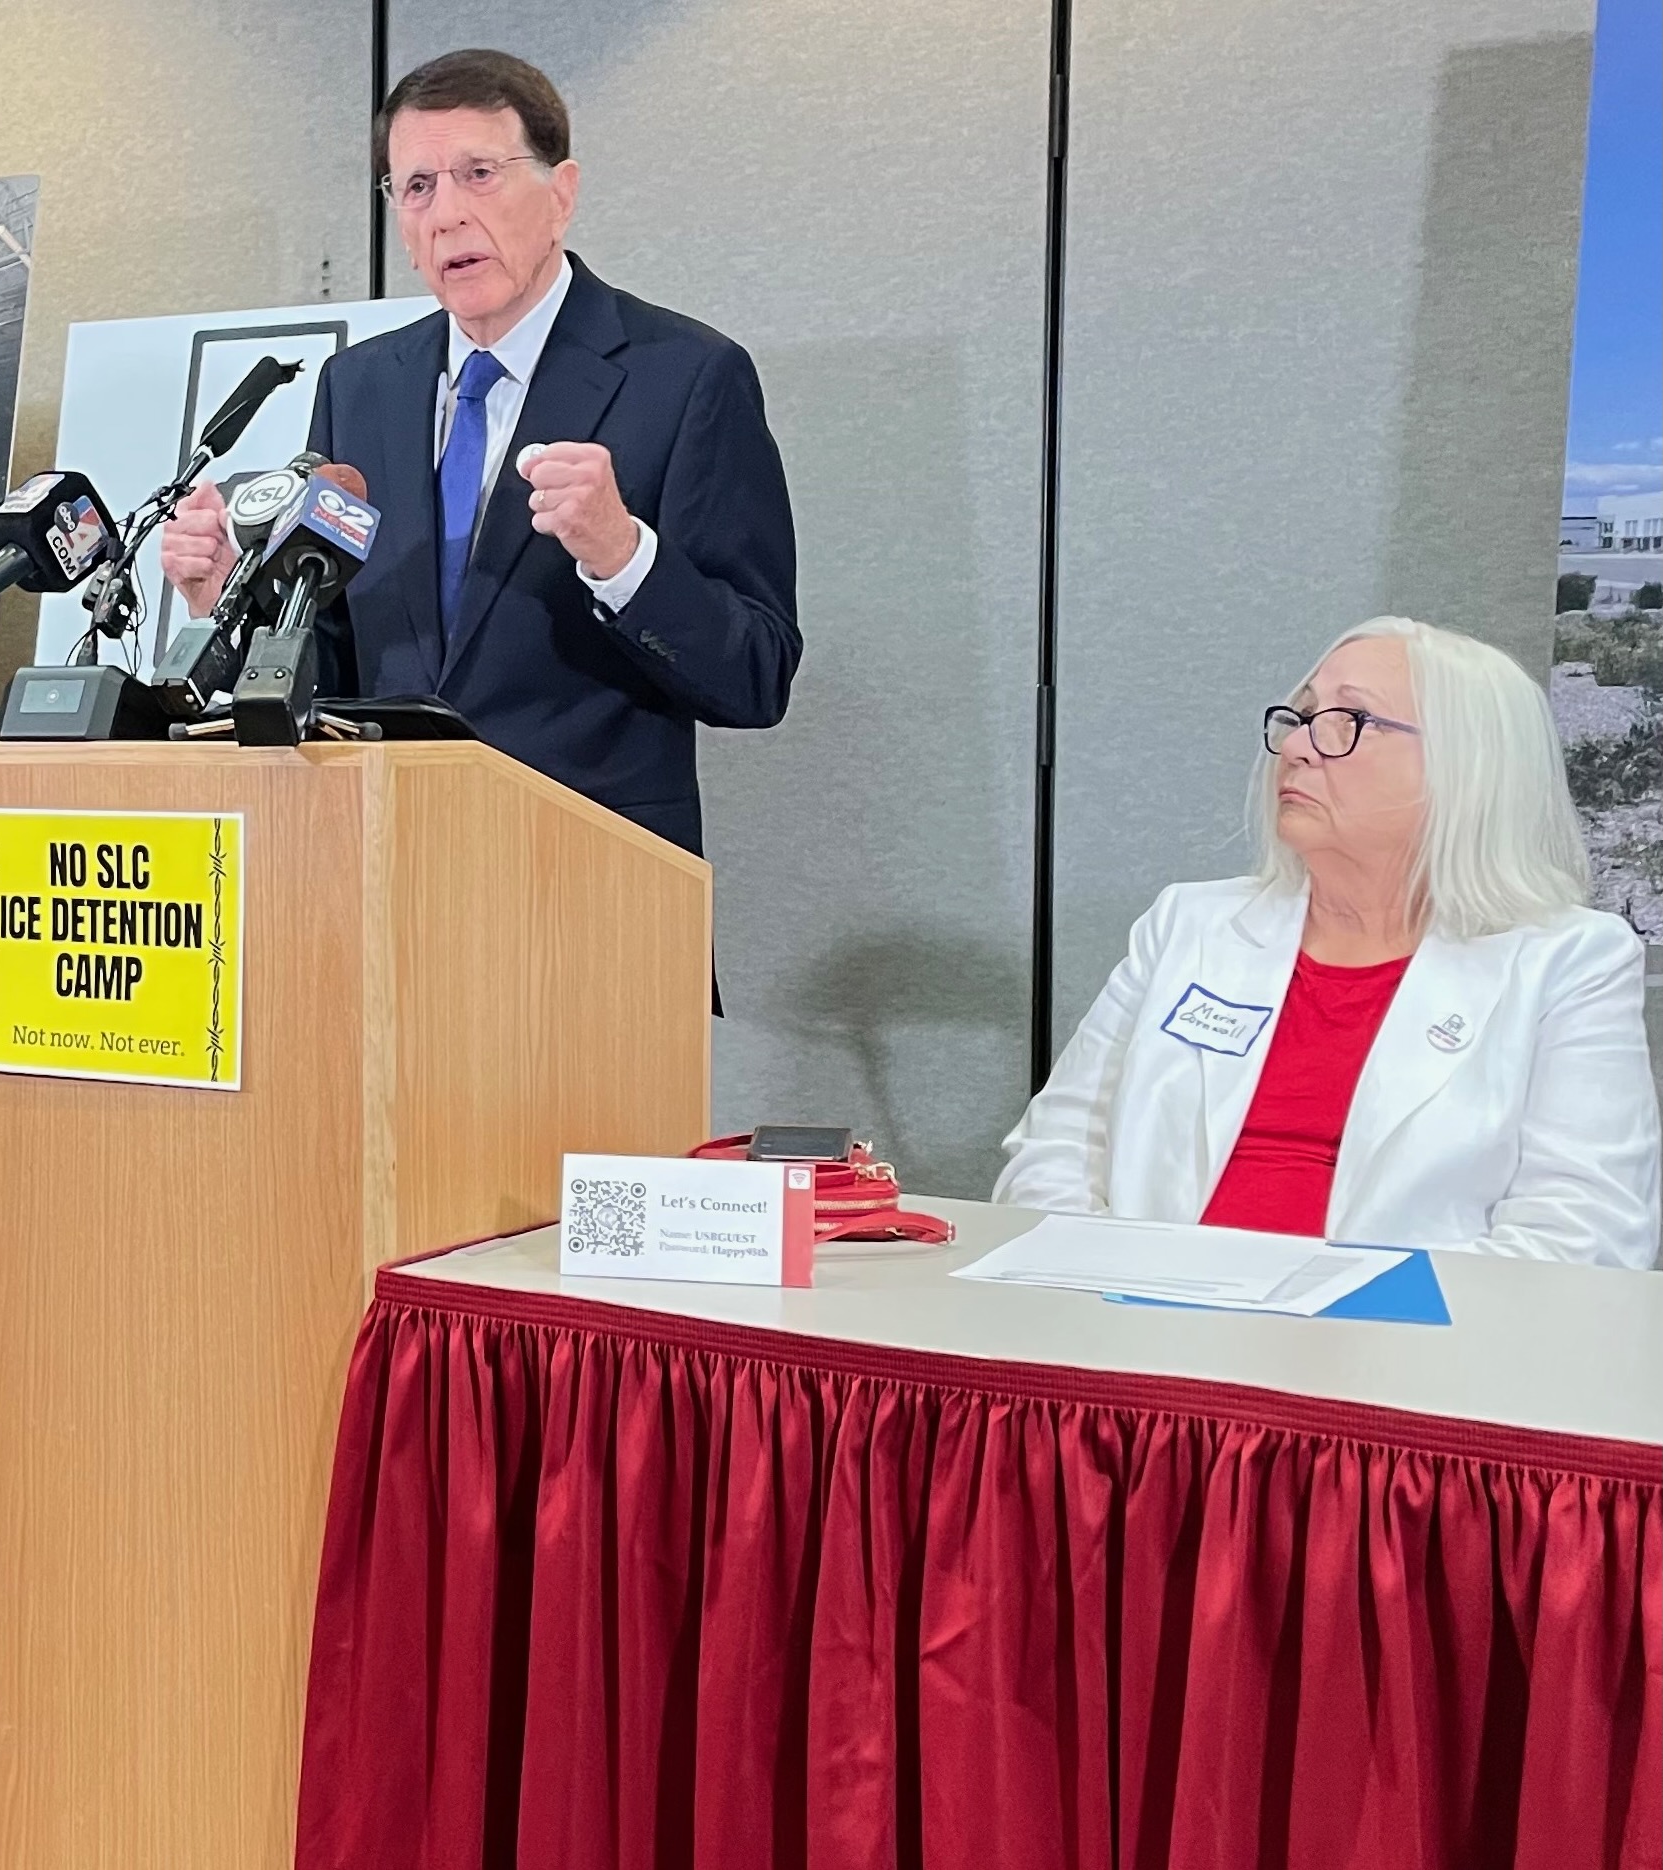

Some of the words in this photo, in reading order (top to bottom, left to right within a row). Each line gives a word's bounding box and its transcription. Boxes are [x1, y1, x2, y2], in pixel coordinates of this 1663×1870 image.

[240, 485, 285, 505] KSL
[57, 505, 77, 532] abc
[313, 506, 367, 545] NEWS
[340, 505, 375, 536] 2
[49, 842, 86, 888] NO
[96, 844, 150, 890] SLC
[0, 895, 42, 941] ICE
[51, 897, 203, 949] DETENTION
[56, 952, 143, 1001] CAMP
[12, 1025, 45, 1046] Not
[49, 1032, 95, 1050] now.
[100, 1031, 135, 1053] Not
[139, 1038, 186, 1057] ever.
[661, 1194, 696, 1209] Let's
[700, 1196, 768, 1214] Connect!
